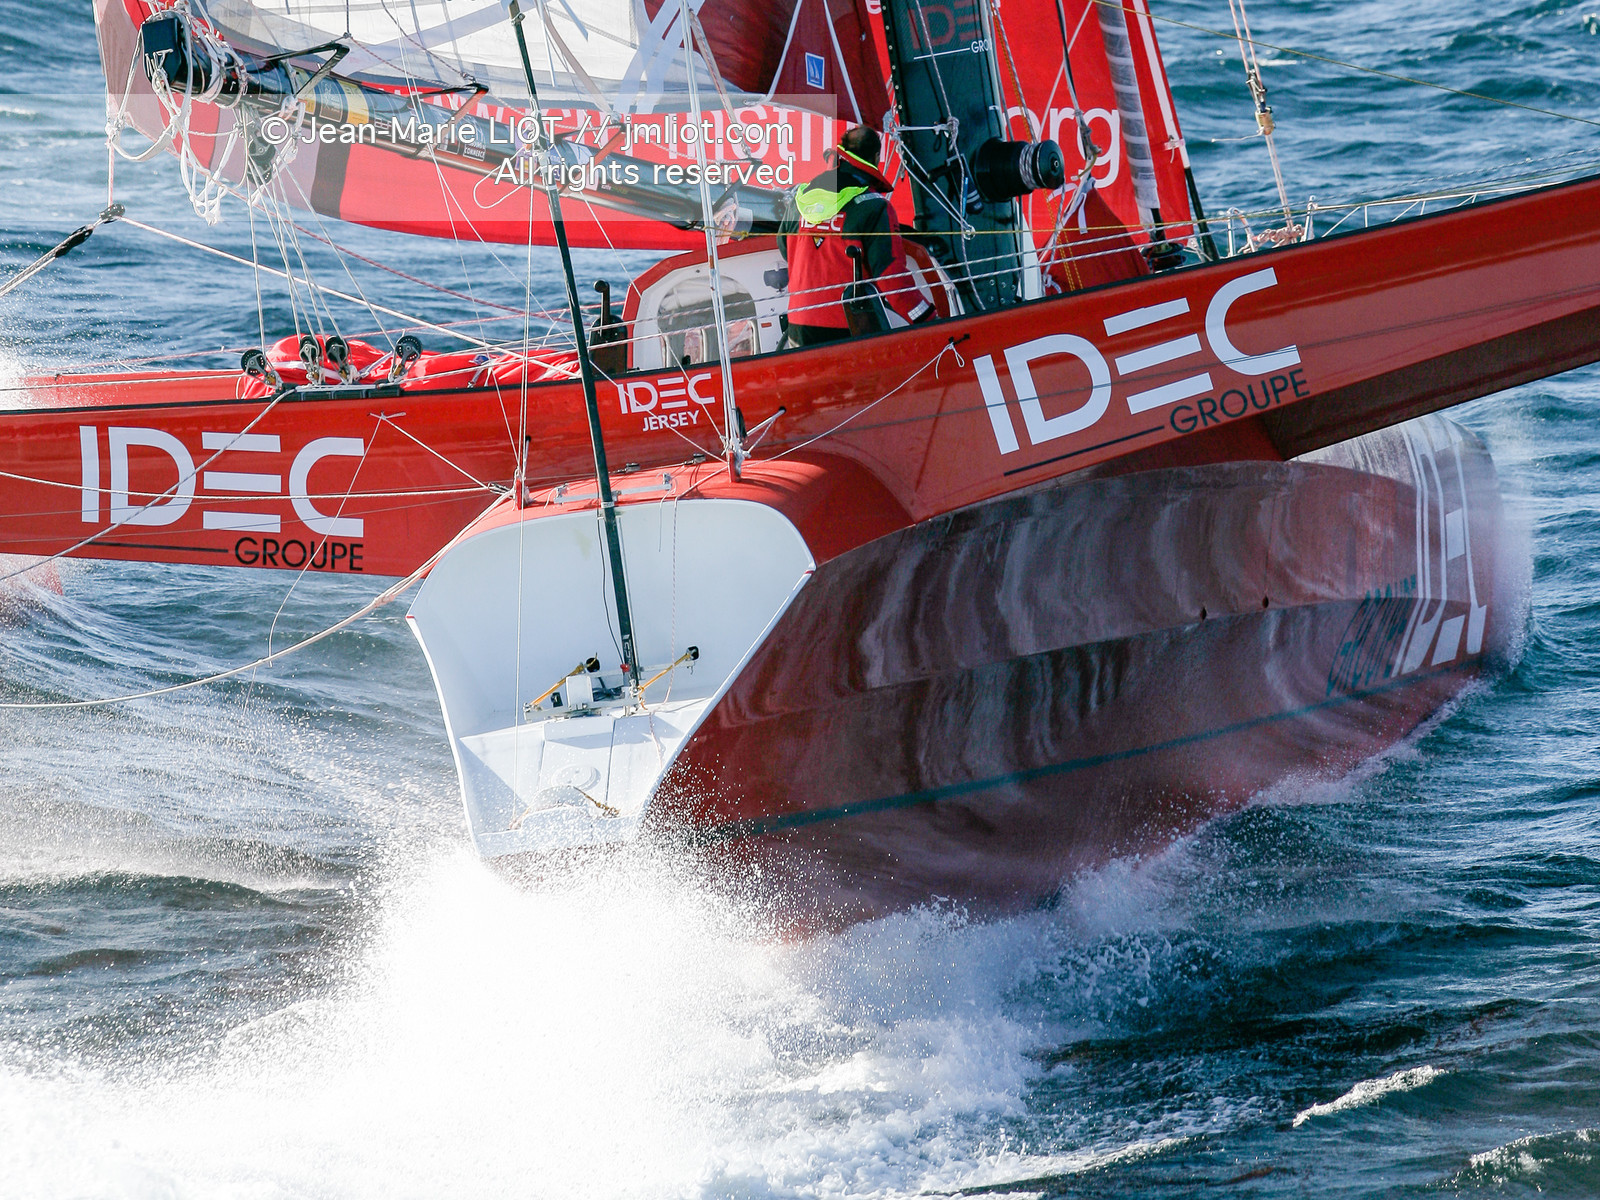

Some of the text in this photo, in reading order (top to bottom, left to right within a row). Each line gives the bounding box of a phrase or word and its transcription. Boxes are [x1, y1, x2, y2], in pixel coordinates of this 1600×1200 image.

[972, 267, 1301, 455] IDEC
[617, 372, 716, 415] IDEC
[642, 409, 700, 432] JERSEY
[1170, 368, 1310, 434] GROUPE
[79, 425, 365, 538] IDEC
[234, 536, 364, 571] GROUPE
